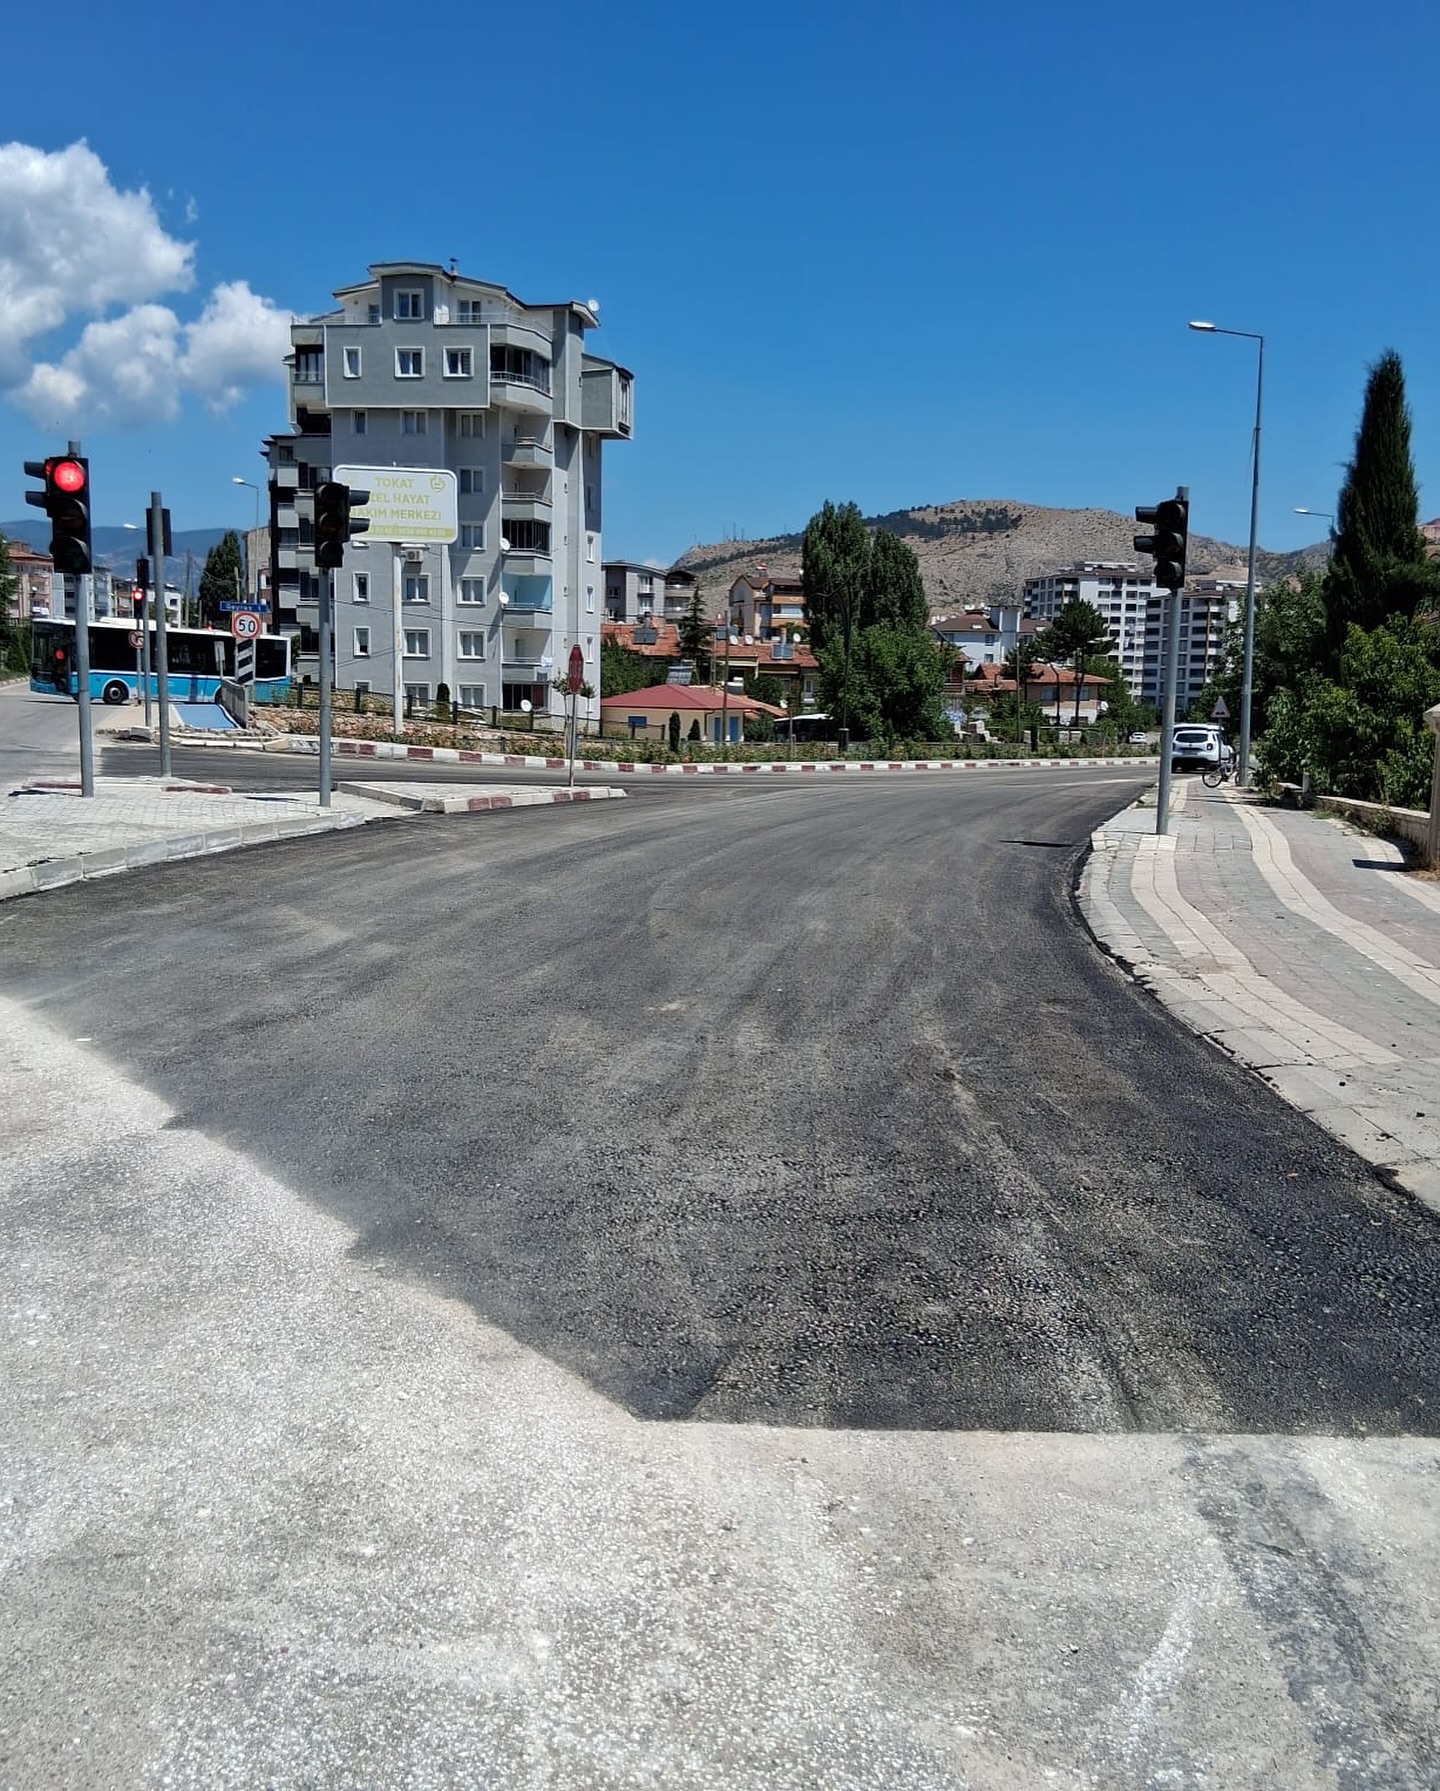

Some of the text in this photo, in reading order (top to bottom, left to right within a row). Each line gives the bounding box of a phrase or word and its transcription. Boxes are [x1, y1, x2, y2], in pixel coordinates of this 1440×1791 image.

[375, 477, 415, 488] TOKAT
[369, 493, 431, 505] ZEL HAYAT
[239, 619, 256, 633] 50
